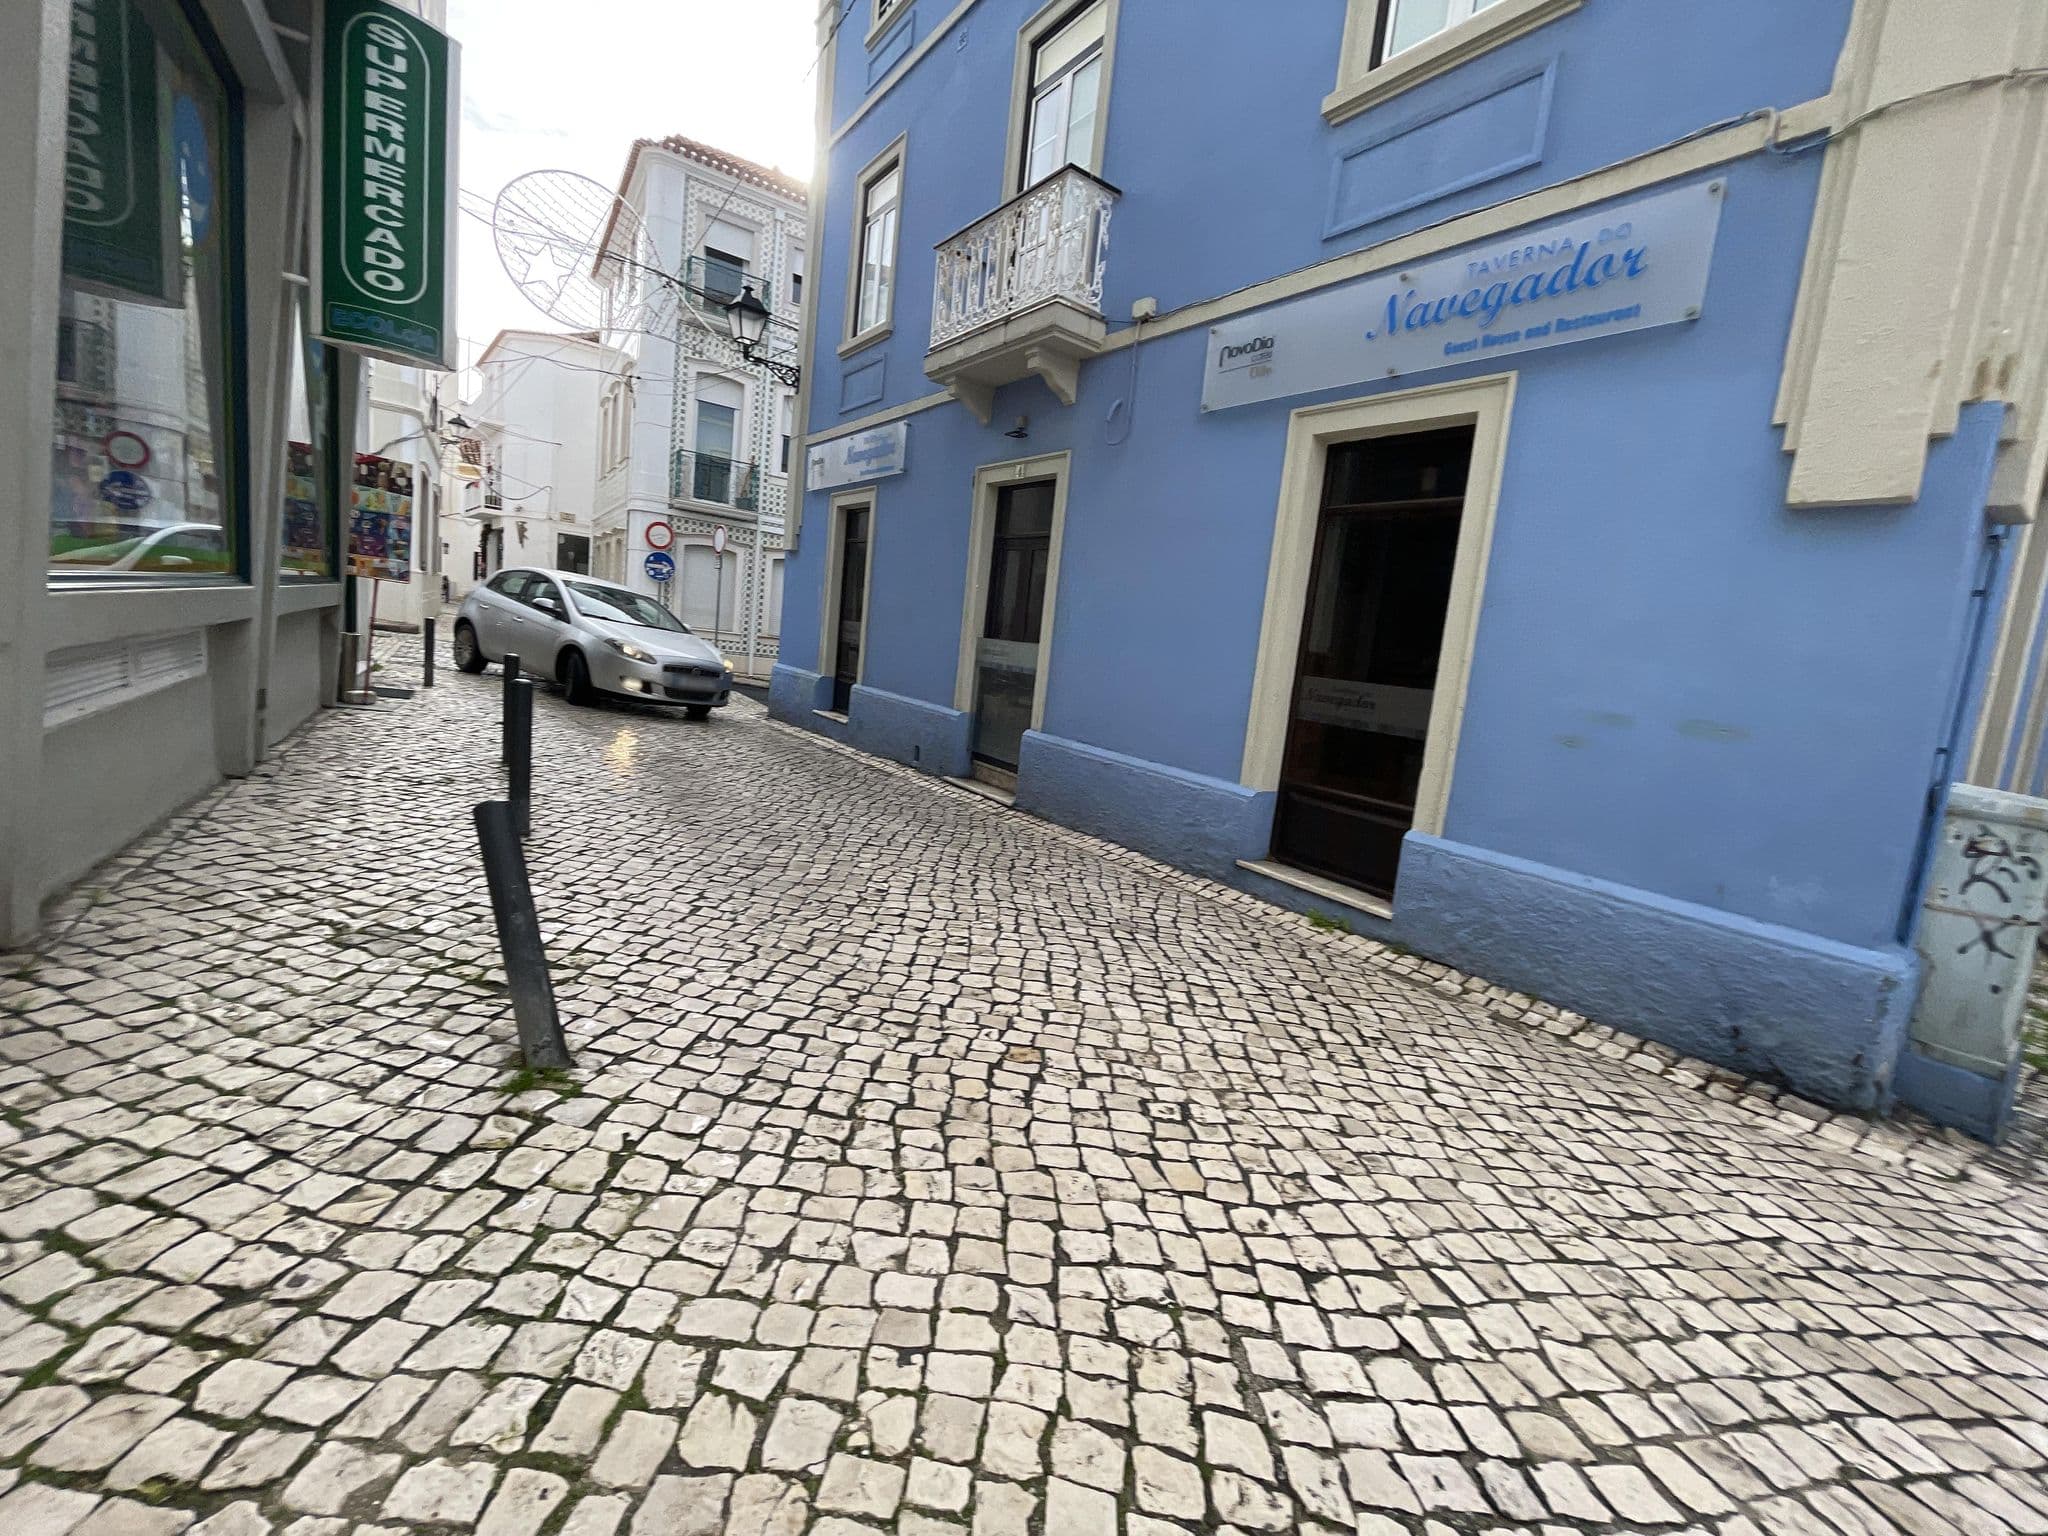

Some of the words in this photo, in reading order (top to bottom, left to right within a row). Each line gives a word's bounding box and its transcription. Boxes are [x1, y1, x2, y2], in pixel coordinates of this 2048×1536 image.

[363, 22, 408, 292] SUPERMERCADO
[1365, 240, 1648, 341] Navegador
[1467, 236, 1574, 277] TAVERNA
[1598, 222, 1632, 244] DO
